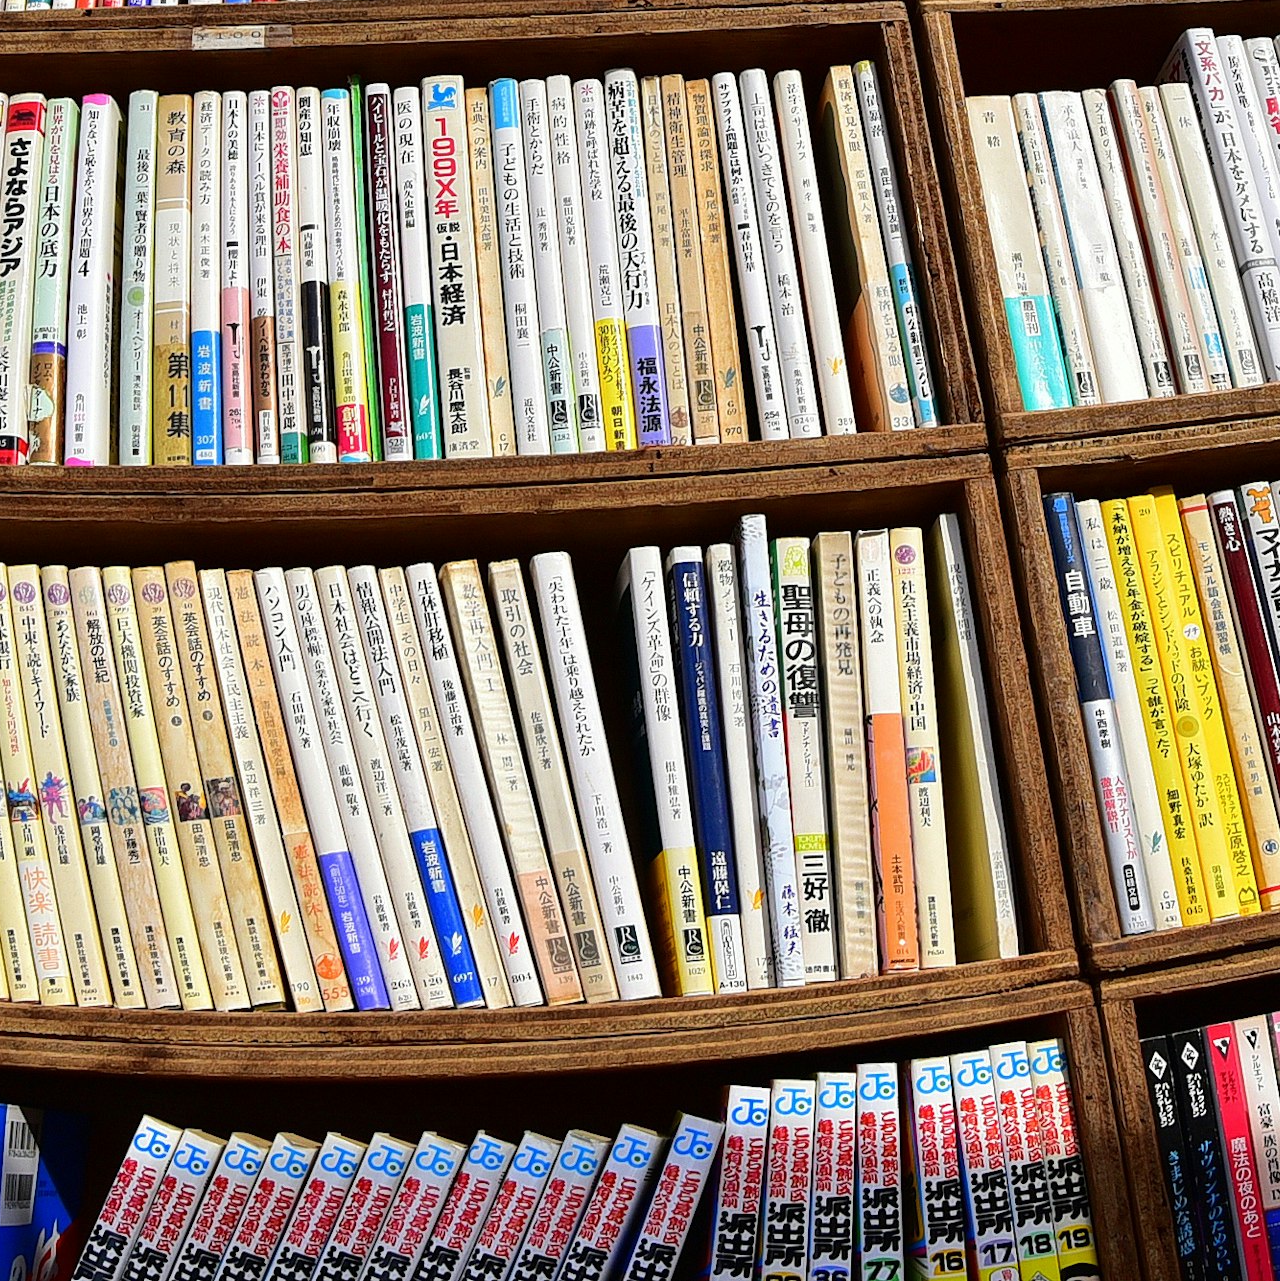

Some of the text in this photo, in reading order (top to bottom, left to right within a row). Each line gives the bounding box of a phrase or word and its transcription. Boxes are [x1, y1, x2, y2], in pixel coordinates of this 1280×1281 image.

[165, 111, 187, 175] 教育の森
[199, 101, 212, 205] 経済データの読み方
[227, 100, 239, 160] 日本人の美徳
[299, 97, 312, 157] 倒産の知恵
[327, 104, 342, 151] 年収崩壊
[396, 100, 415, 164] 医の現在
[431, 117, 461, 218] 199X年
[471, 101, 487, 170] 古典への案内
[526, 99, 544, 176] 手術とからだ
[552, 98, 570, 165] 病的性格
[584, 109, 603, 200] 奇跡と呼ばれた学校
[666, 93, 688, 178] 精神衛生管理
[692, 94, 714, 171] 物質理論の探求
[718, 83, 743, 185] サブプライム問題とは何か
[1195, 33, 1265, 254] 「文系バカ」が、日本をダメにする
[0, 137, 32, 278] さよならアジア
[134, 149, 152, 282] 最後の一葉・賢者の贈り物
[254, 122, 268, 258] 日本にノーベル賞が来る理由
[370, 95, 395, 281] ハイヒールと宝石が温暖化をもたらす
[500, 142, 525, 279] 子どもの生活と技術
[609, 81, 644, 311] 病苦を超える最後の天行力
[750, 93, 783, 254] 上司は思いつきでものを言う
[38, 186, 60, 279] 日本の底力
[777, 273, 794, 315] 橋本治
[167, 353, 189, 437] 第11集
[197, 345, 212, 411] 岩波新書
[448, 368, 468, 434] 長谷川慶太郎
[637, 357, 662, 433] 福永法源
[196, 436, 214, 444] 307
[681, 572, 704, 648] 信頼する力
[829, 554, 854, 676] 子どもの再発見
[1064, 569, 1096, 638] 自動車
[1167, 533, 1195, 617] スピリチュアル
[55, 620, 80, 703] あたたかい家族
[182, 611, 212, 702] 英会話のすすめ
[265, 584, 296, 674] パソコン入門
[329, 583, 375, 739] 日本社会はどこへ行く
[416, 579, 449, 662] 生体肝移植
[499, 587, 536, 676] 取引の社会
[639, 570, 672, 721] 「ケインズ革命」の群像
[779, 584, 820, 720] 聖母の復讐
[899, 579, 927, 732] 社会主義市場経済の中国
[1147, 550, 1190, 712] アラジンとシンドバッドの冒険
[207, 587, 249, 740] 現代日本社会と民主主義
[548, 577, 597, 758] 「失われた十年」は乗り越えられたか
[752, 591, 782, 739] 生きるための遺書
[22, 867, 53, 914] 快楽
[800, 854, 831, 934] 三好徹
[31, 923, 60, 969] 読書
[926, 1178, 964, 1244] 派出所
[1167, 1150, 1194, 1257] きまじめな誘惑
[1231, 1138, 1262, 1238] 魔法の夜のあと
[932, 1251, 963, 1269] 16
[983, 1243, 1013, 1263] 17
[1021, 1234, 1052, 1254] 18
[1057, 1228, 1090, 1247] 19
